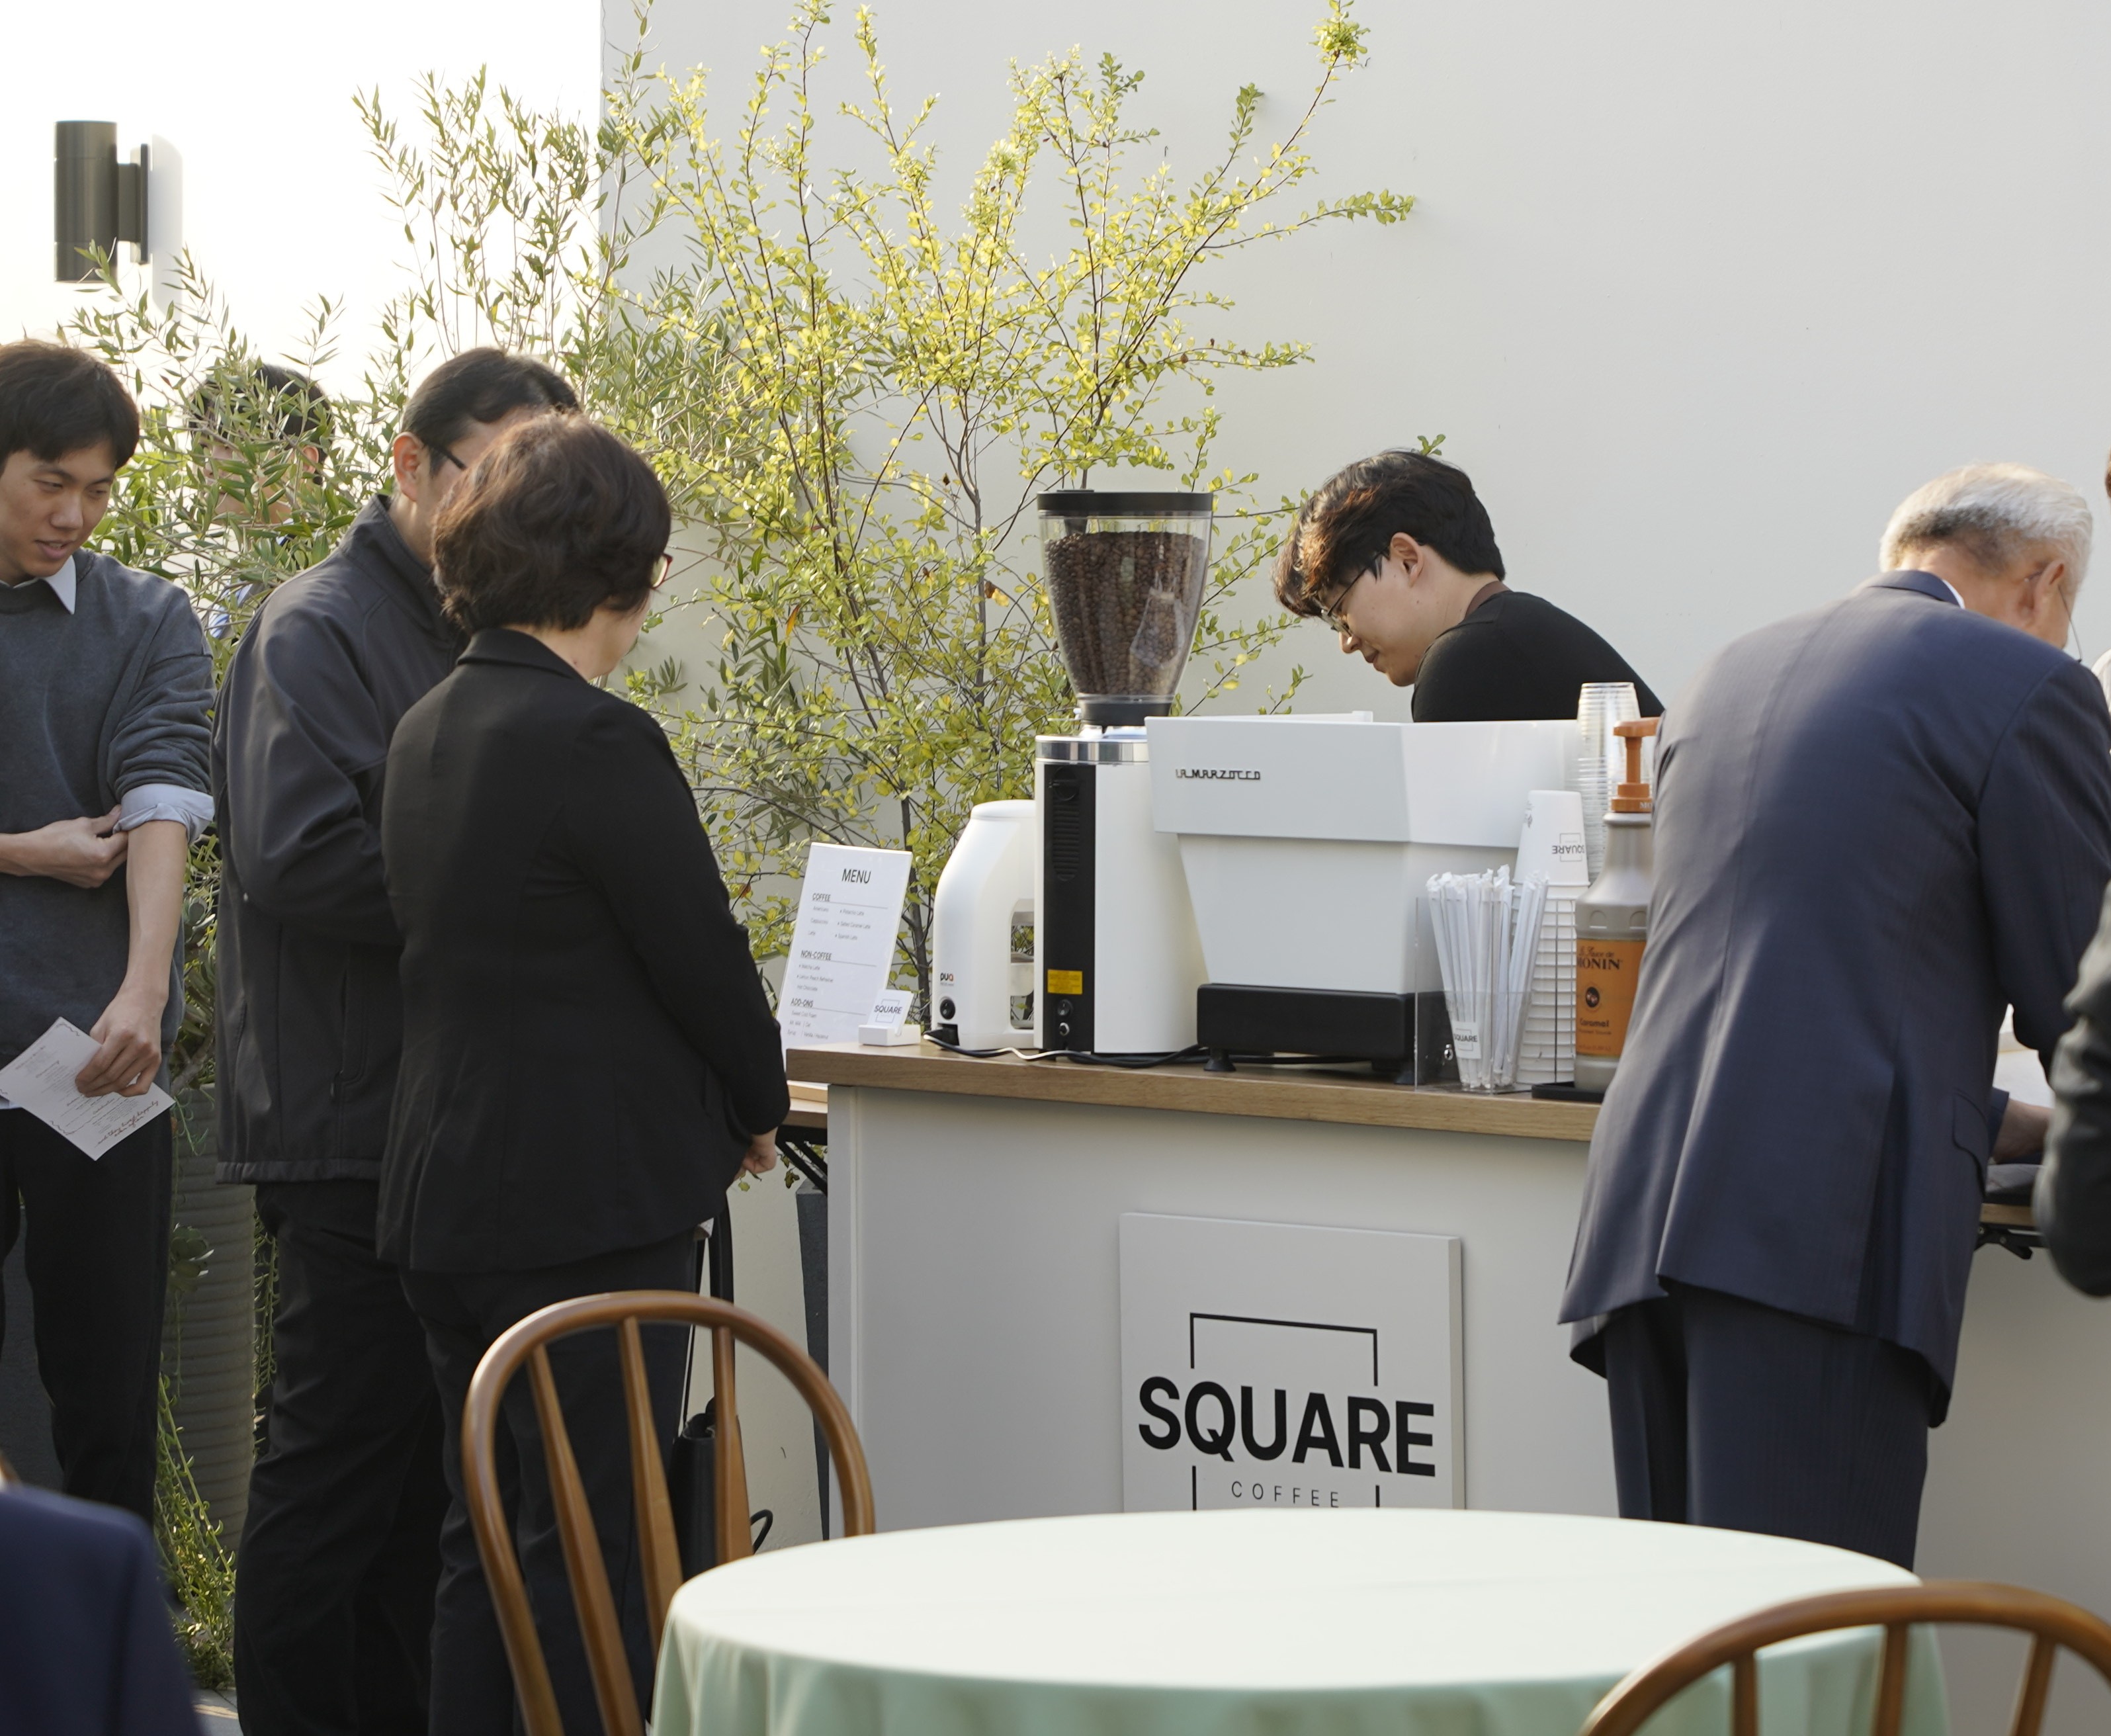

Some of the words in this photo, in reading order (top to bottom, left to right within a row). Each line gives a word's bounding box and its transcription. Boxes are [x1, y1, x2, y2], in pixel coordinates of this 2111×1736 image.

[841, 869, 871, 884] MENU
[812, 893, 831, 902] COFFEE
[800, 950, 832, 961] NON-COFFEE
[791, 998, 813, 1008] ADD-ONS
[874, 1005, 902, 1014] SQUARE
[1139, 1376, 1436, 1477] SQUARE
[1232, 1481, 1339, 1508] COFFEE
